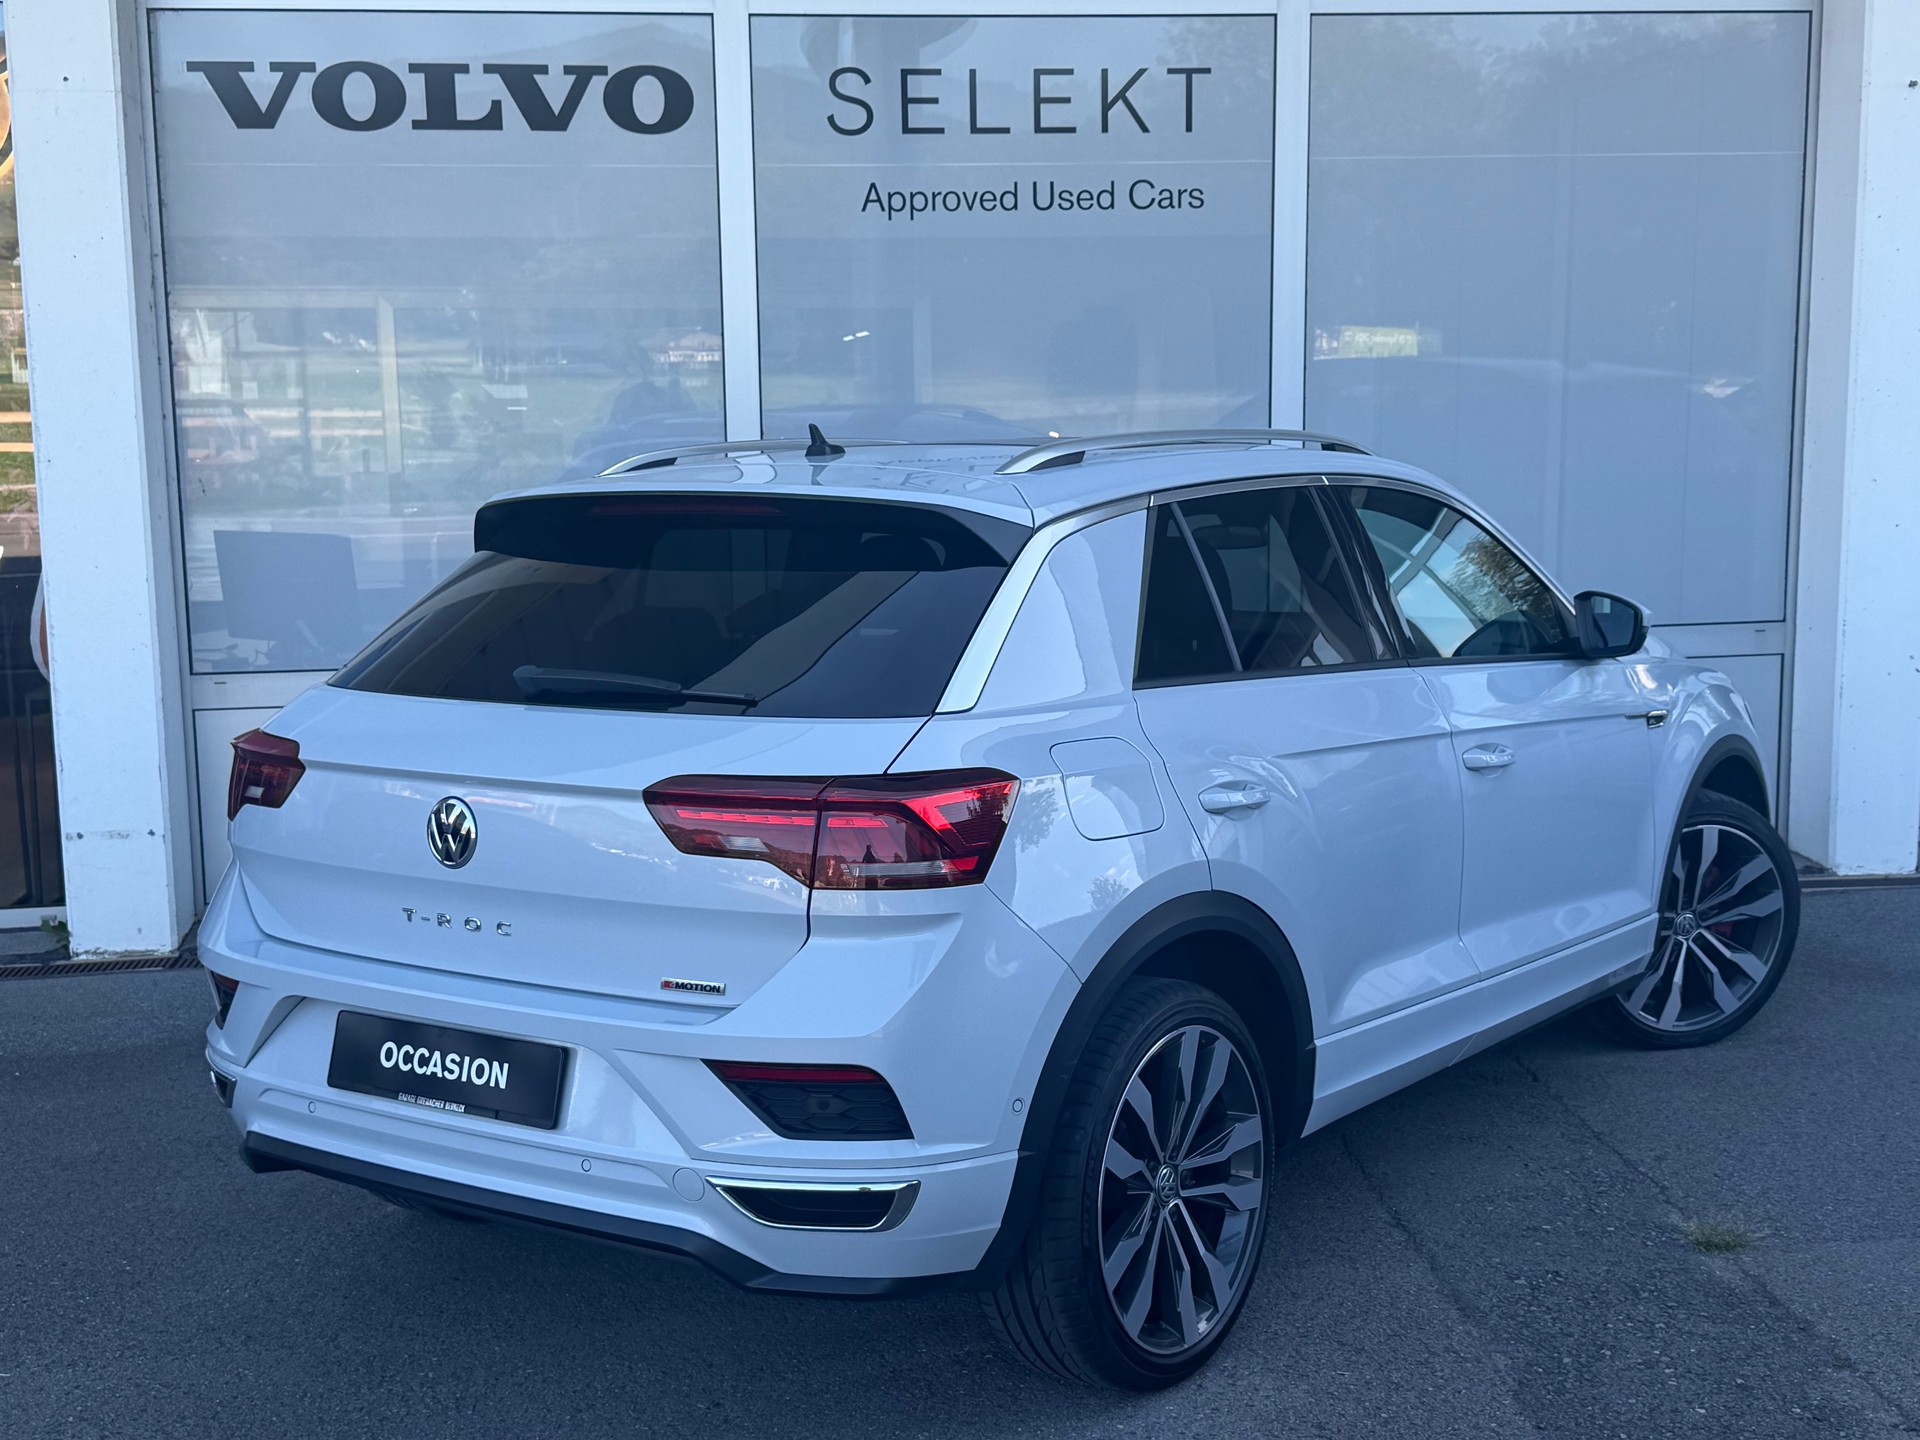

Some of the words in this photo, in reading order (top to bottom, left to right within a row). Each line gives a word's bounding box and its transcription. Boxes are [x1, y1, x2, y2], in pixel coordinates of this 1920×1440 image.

[186, 60, 695, 135] VOLVO
[826, 66, 1213, 136] SELEKT
[861, 181, 1019, 221] Approved
[1032, 180, 1116, 211] Used
[1128, 178, 1206, 211] Cars
[402, 907, 512, 936] T-ROC
[379, 1041, 509, 1090] OCCASION
